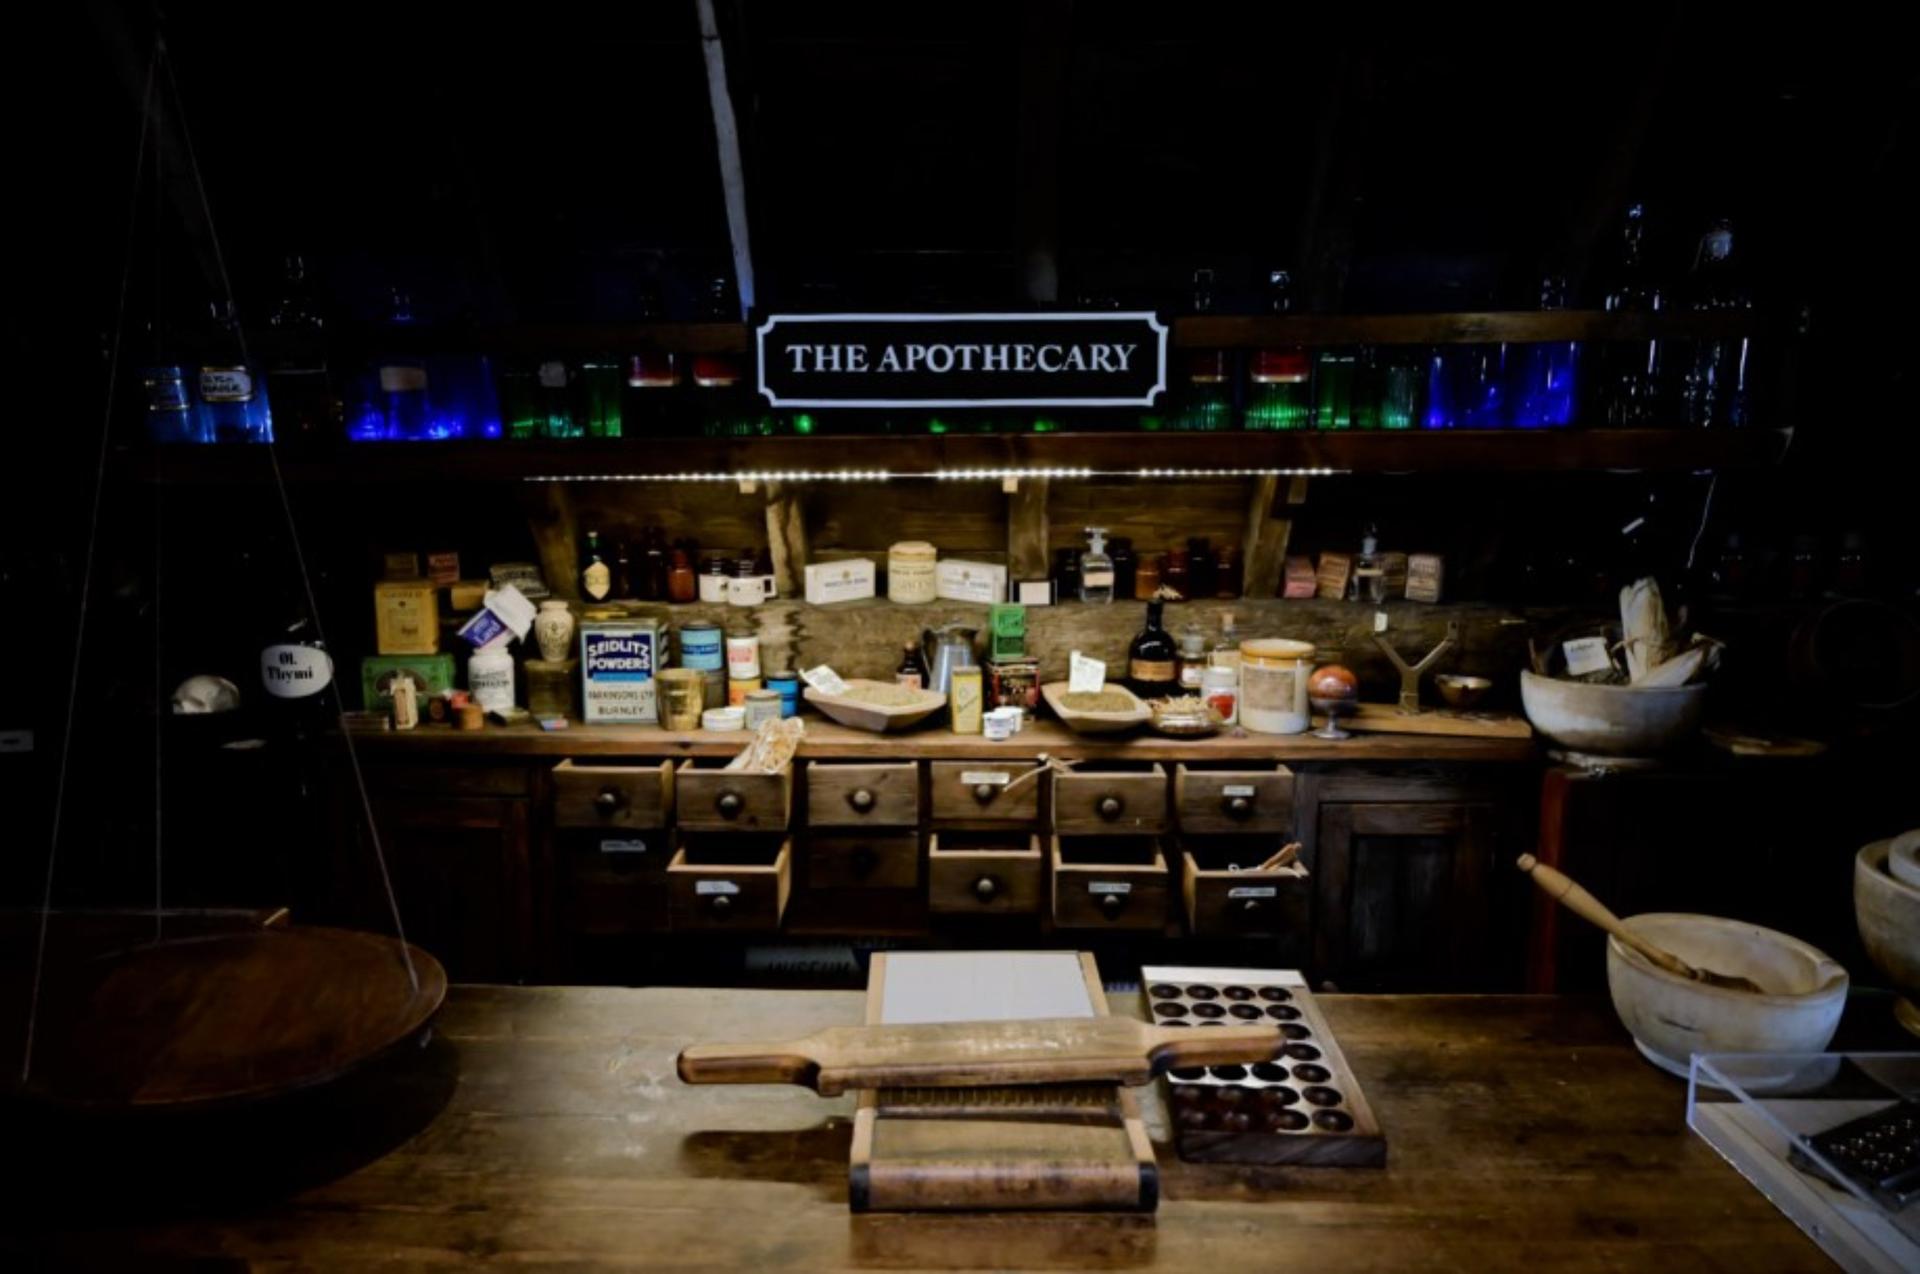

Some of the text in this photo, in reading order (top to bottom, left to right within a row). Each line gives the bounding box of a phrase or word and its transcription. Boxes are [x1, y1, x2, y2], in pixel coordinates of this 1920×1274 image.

[785, 343, 1138, 374] THE APOTHECARY
[588, 639, 649, 658] SEIDLITZ
[588, 654, 650, 670] POWDERS
[267, 661, 313, 683] Thymi
[597, 705, 645, 716] BURNLEY
